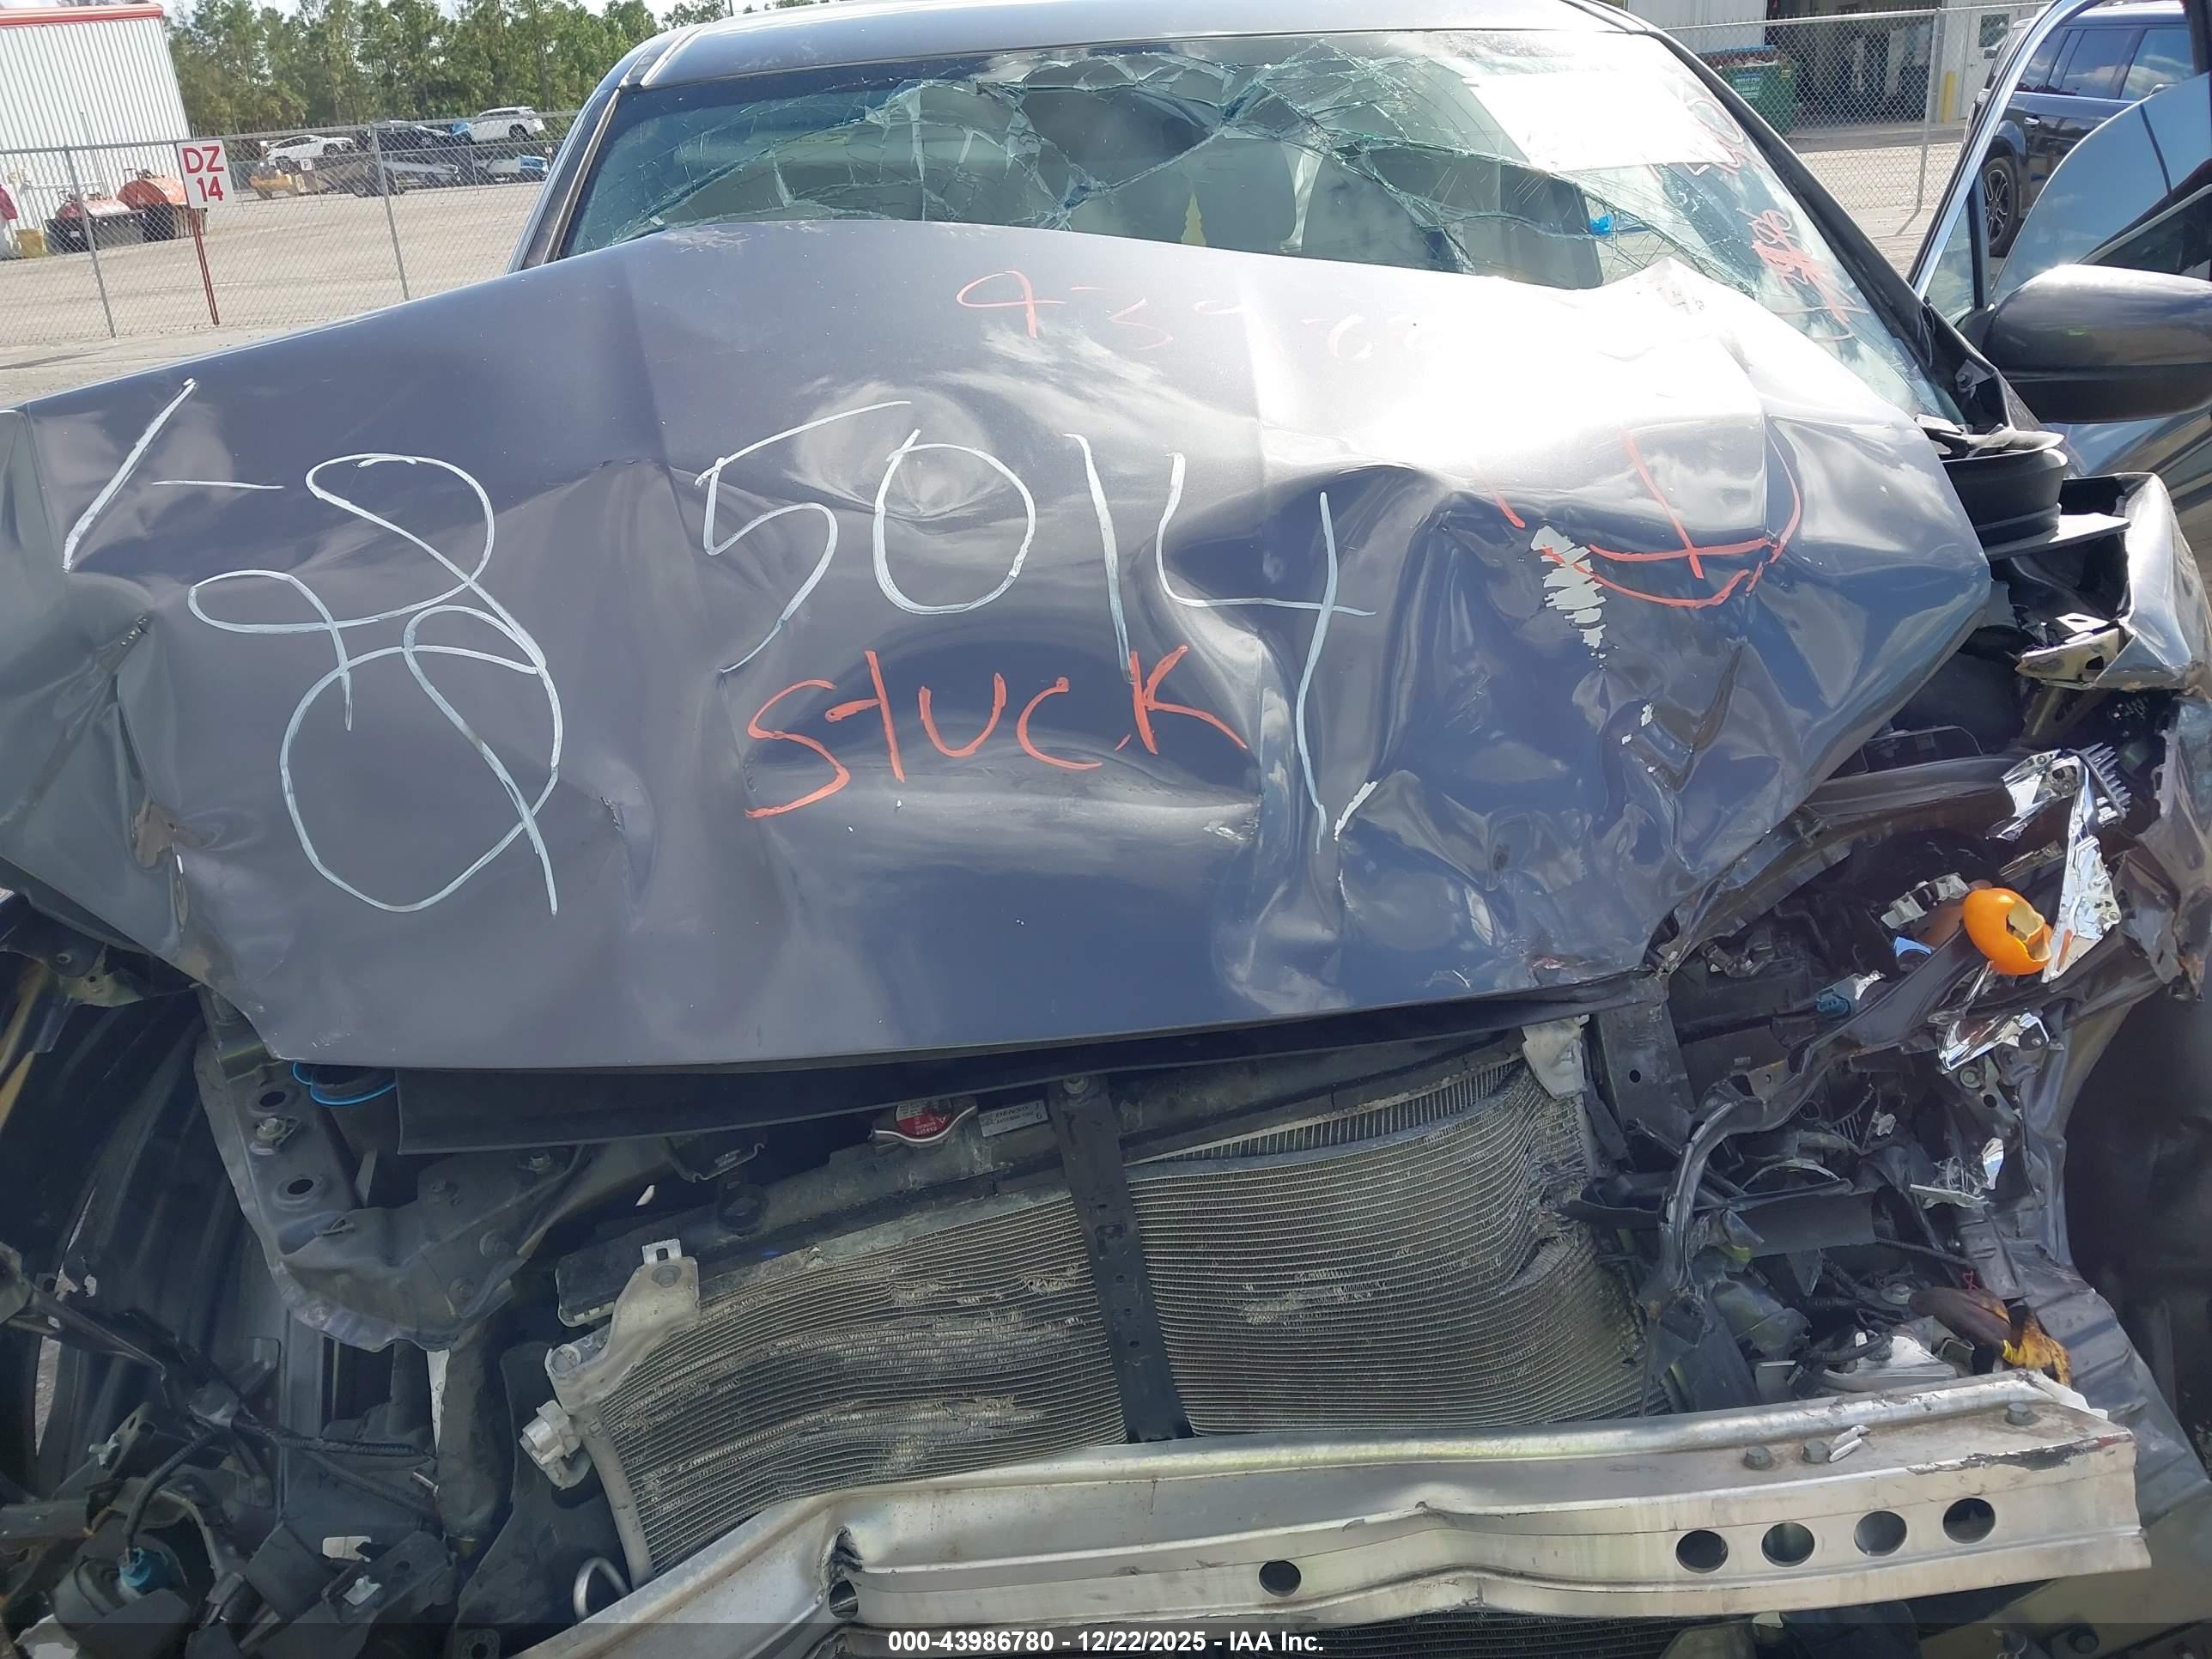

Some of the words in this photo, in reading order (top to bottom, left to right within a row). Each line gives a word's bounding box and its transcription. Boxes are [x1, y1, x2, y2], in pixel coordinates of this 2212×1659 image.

[182, 146, 224, 173] DZ
[197, 176, 223, 202] 14
[744, 644, 1248, 818] STUCK
